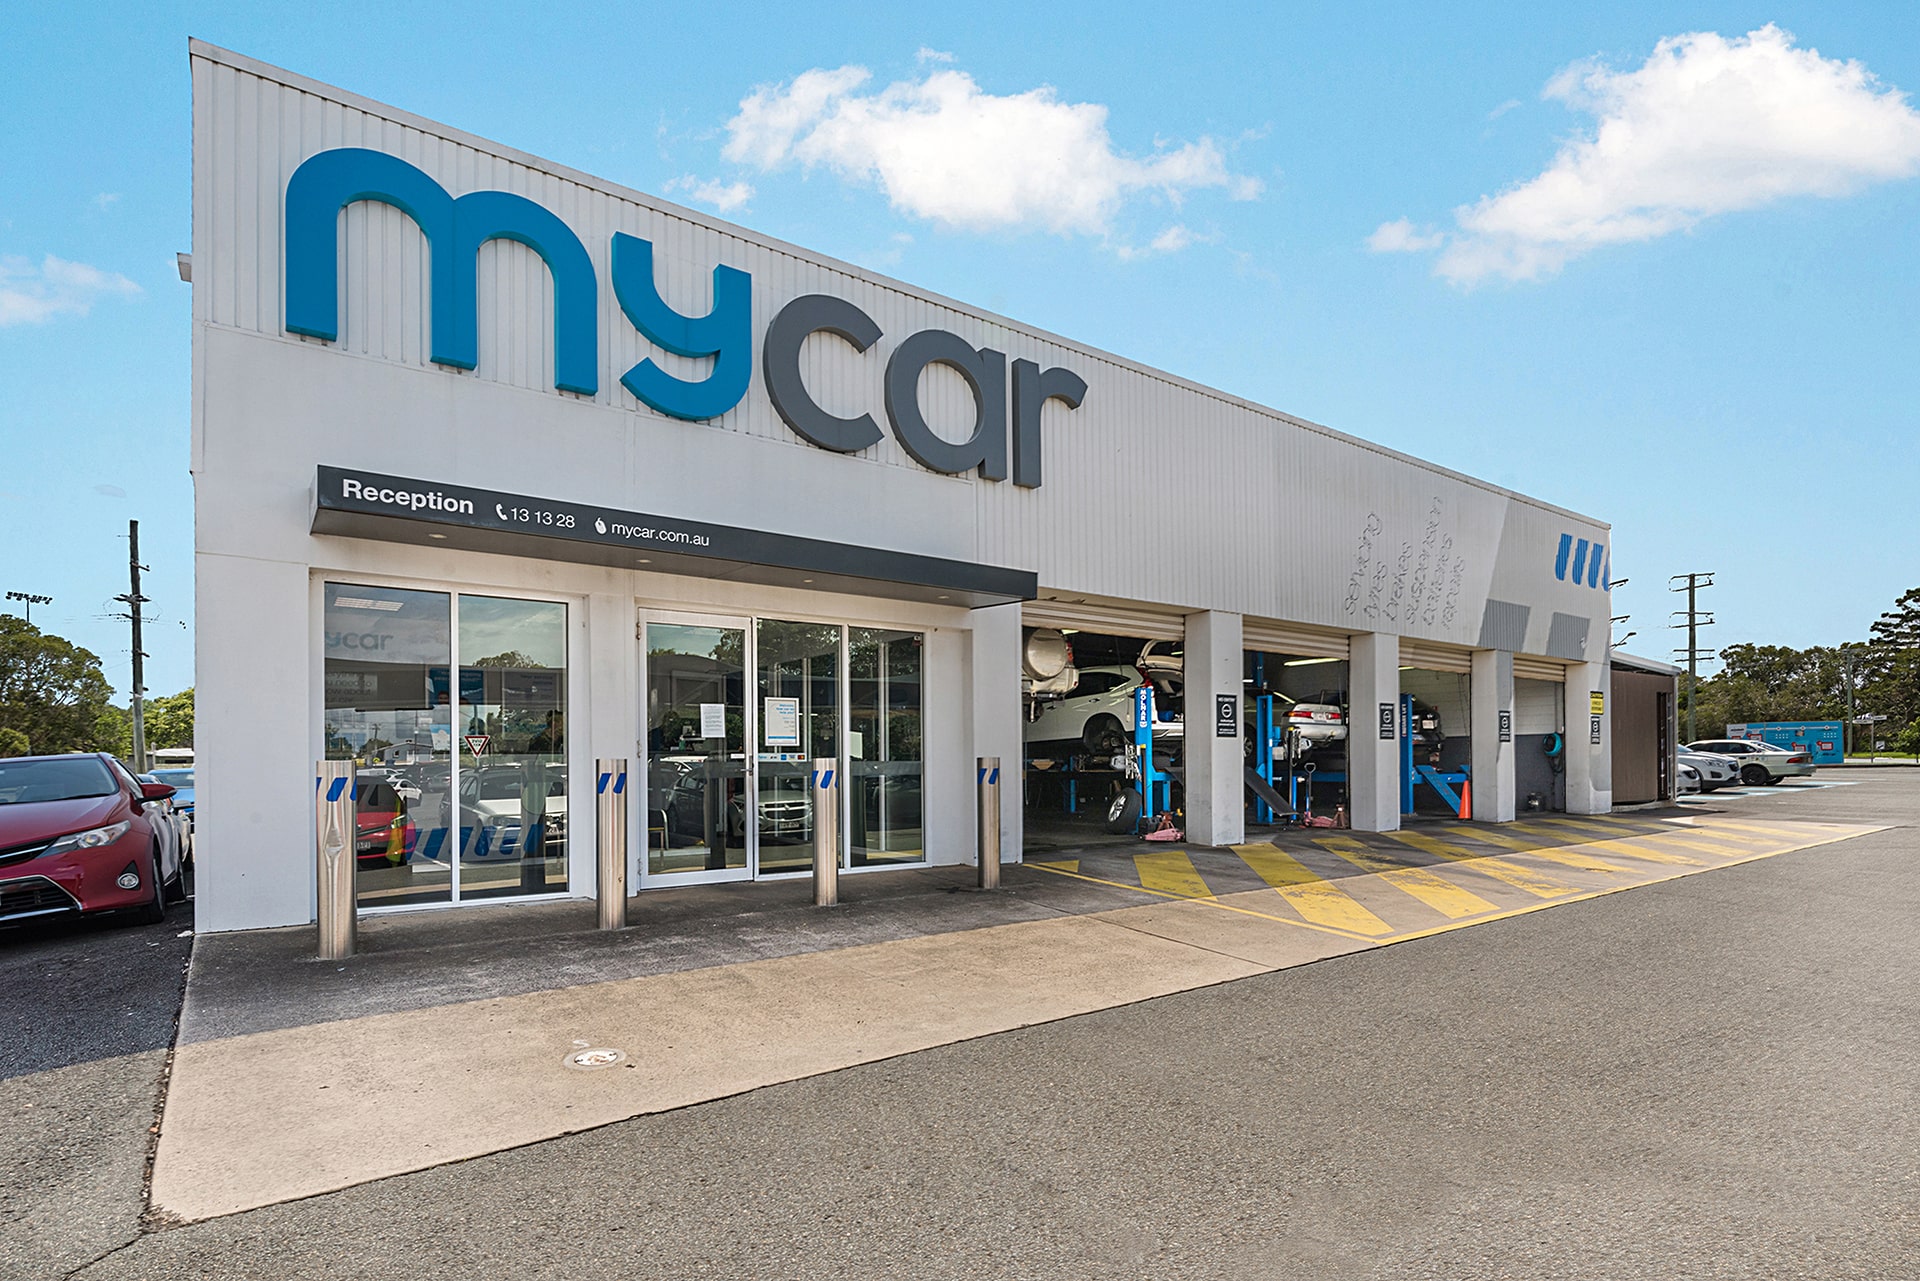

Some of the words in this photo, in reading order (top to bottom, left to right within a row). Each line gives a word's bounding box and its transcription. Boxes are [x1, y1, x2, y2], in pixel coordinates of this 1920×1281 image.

[285, 147, 1088, 489] mycar
[343, 478, 474, 515] Reception
[511, 507, 530, 522] 13
[535, 511, 552, 526] 13
[556, 514, 576, 528] 28
[611, 522, 710, 547] mycar.com.au
[1345, 513, 1382, 615] servicing
[325, 631, 394, 650] ycar
